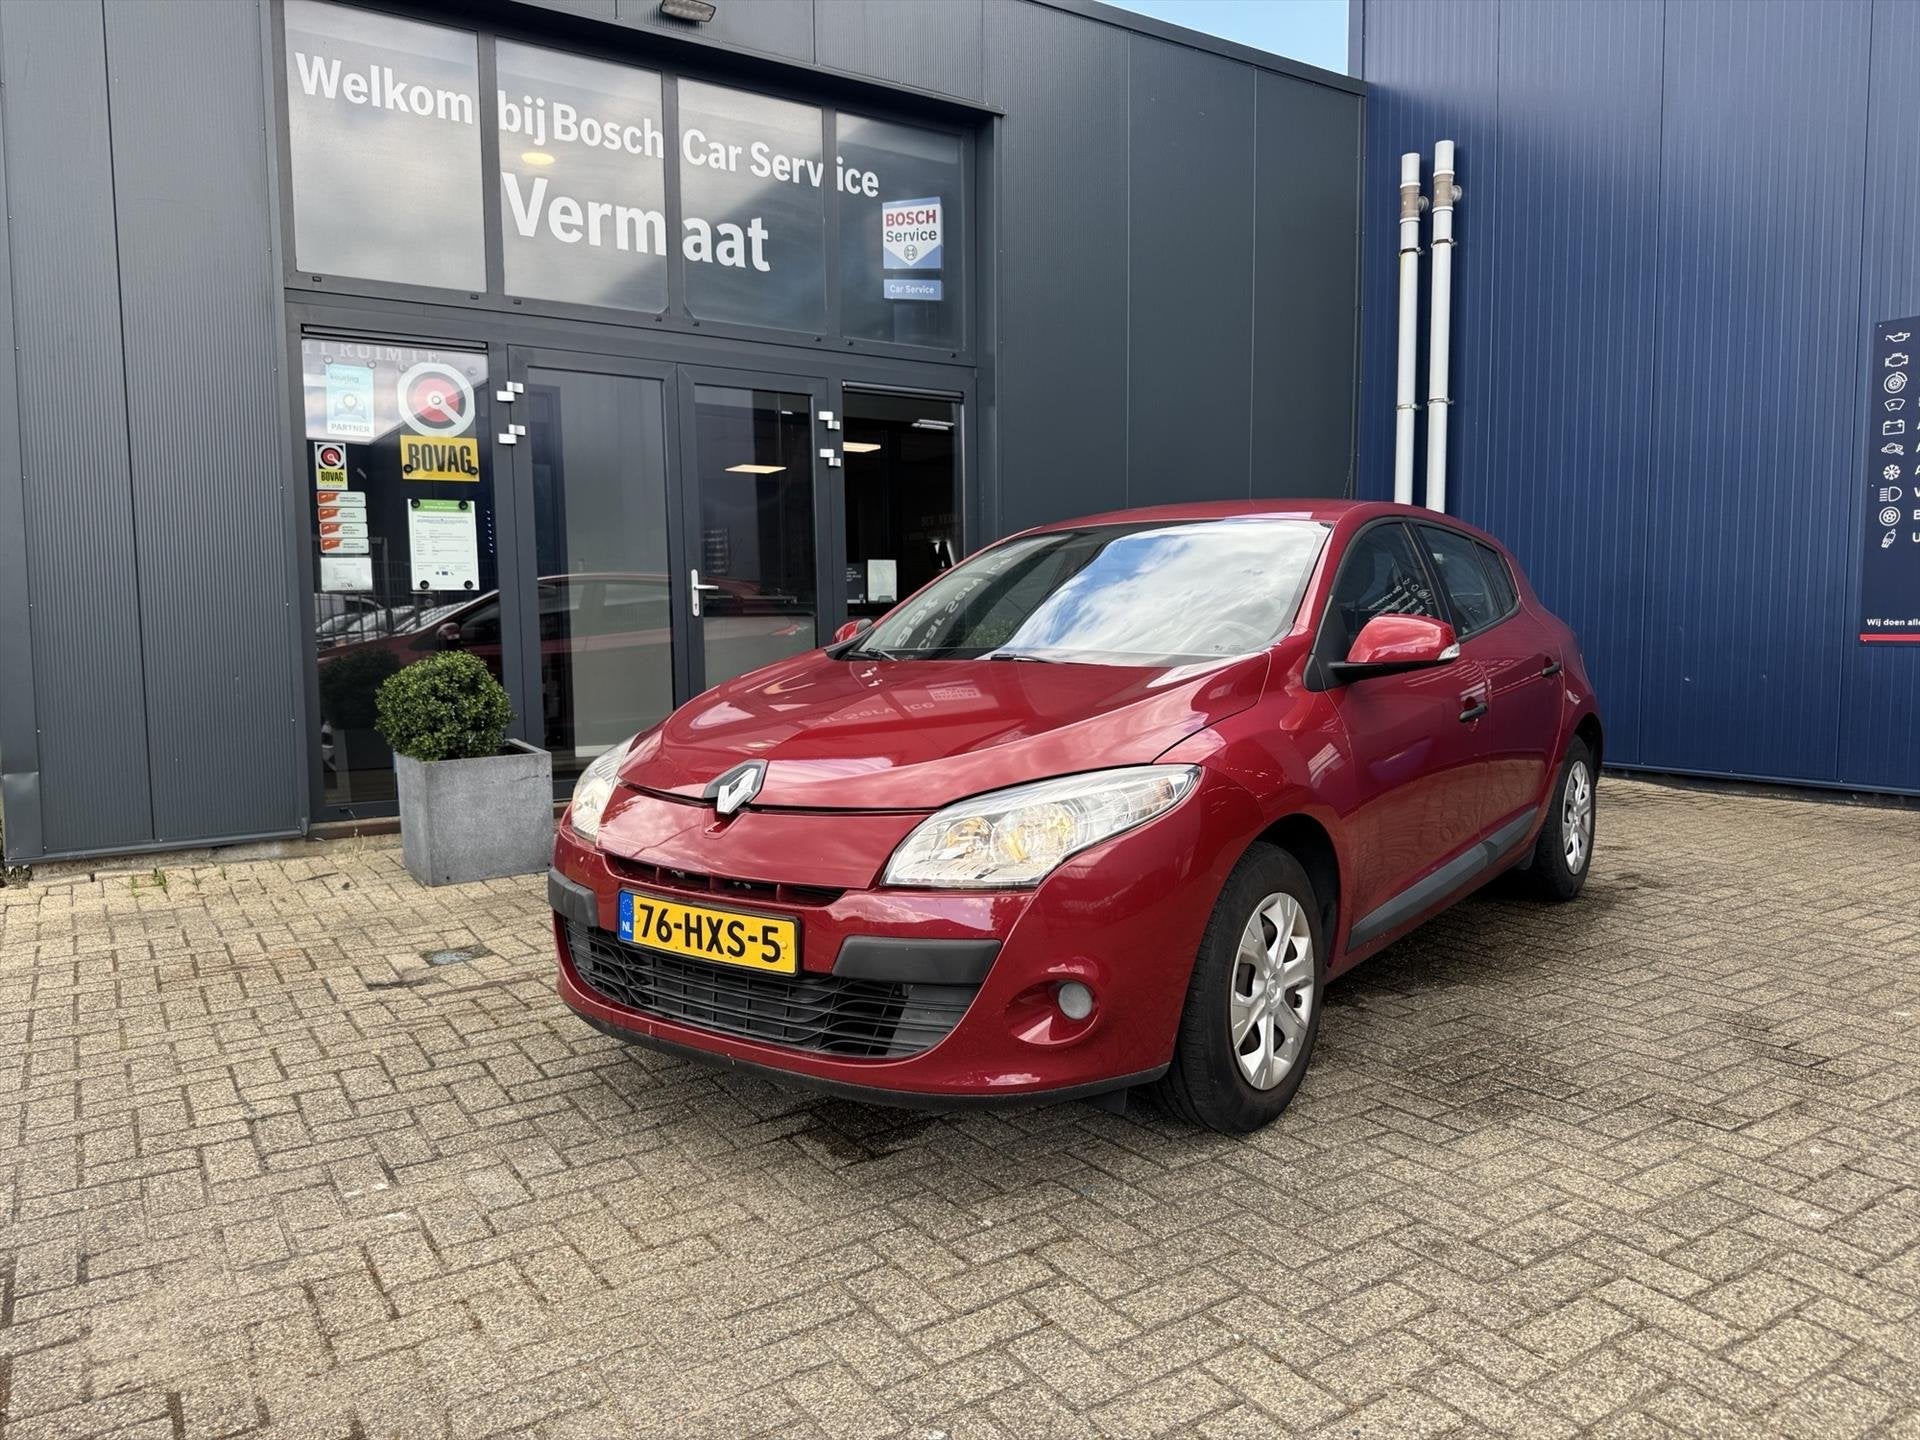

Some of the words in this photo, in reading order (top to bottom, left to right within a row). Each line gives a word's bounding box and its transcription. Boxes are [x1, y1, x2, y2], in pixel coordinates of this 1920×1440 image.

[295, 52, 473, 125] Welkom
[499, 91, 547, 145] bij
[553, 103, 664, 159] Bosch
[683, 129, 741, 173] Car
[500, 172, 770, 272] Vermaat
[886, 210, 937, 227] BOSCH
[886, 228, 937, 243] Service
[890, 284, 905, 294] Car
[906, 284, 935, 294] Service
[330, 423, 370, 433] PARTNER
[407, 443, 473, 475] BOVAG
[321, 471, 344, 482] BOVAG
[1867, 618, 1881, 627] Wij
[1883, 618, 1905, 627] doen
[622, 921, 633, 933] NL
[639, 904, 782, 963] 76-HXS-5
